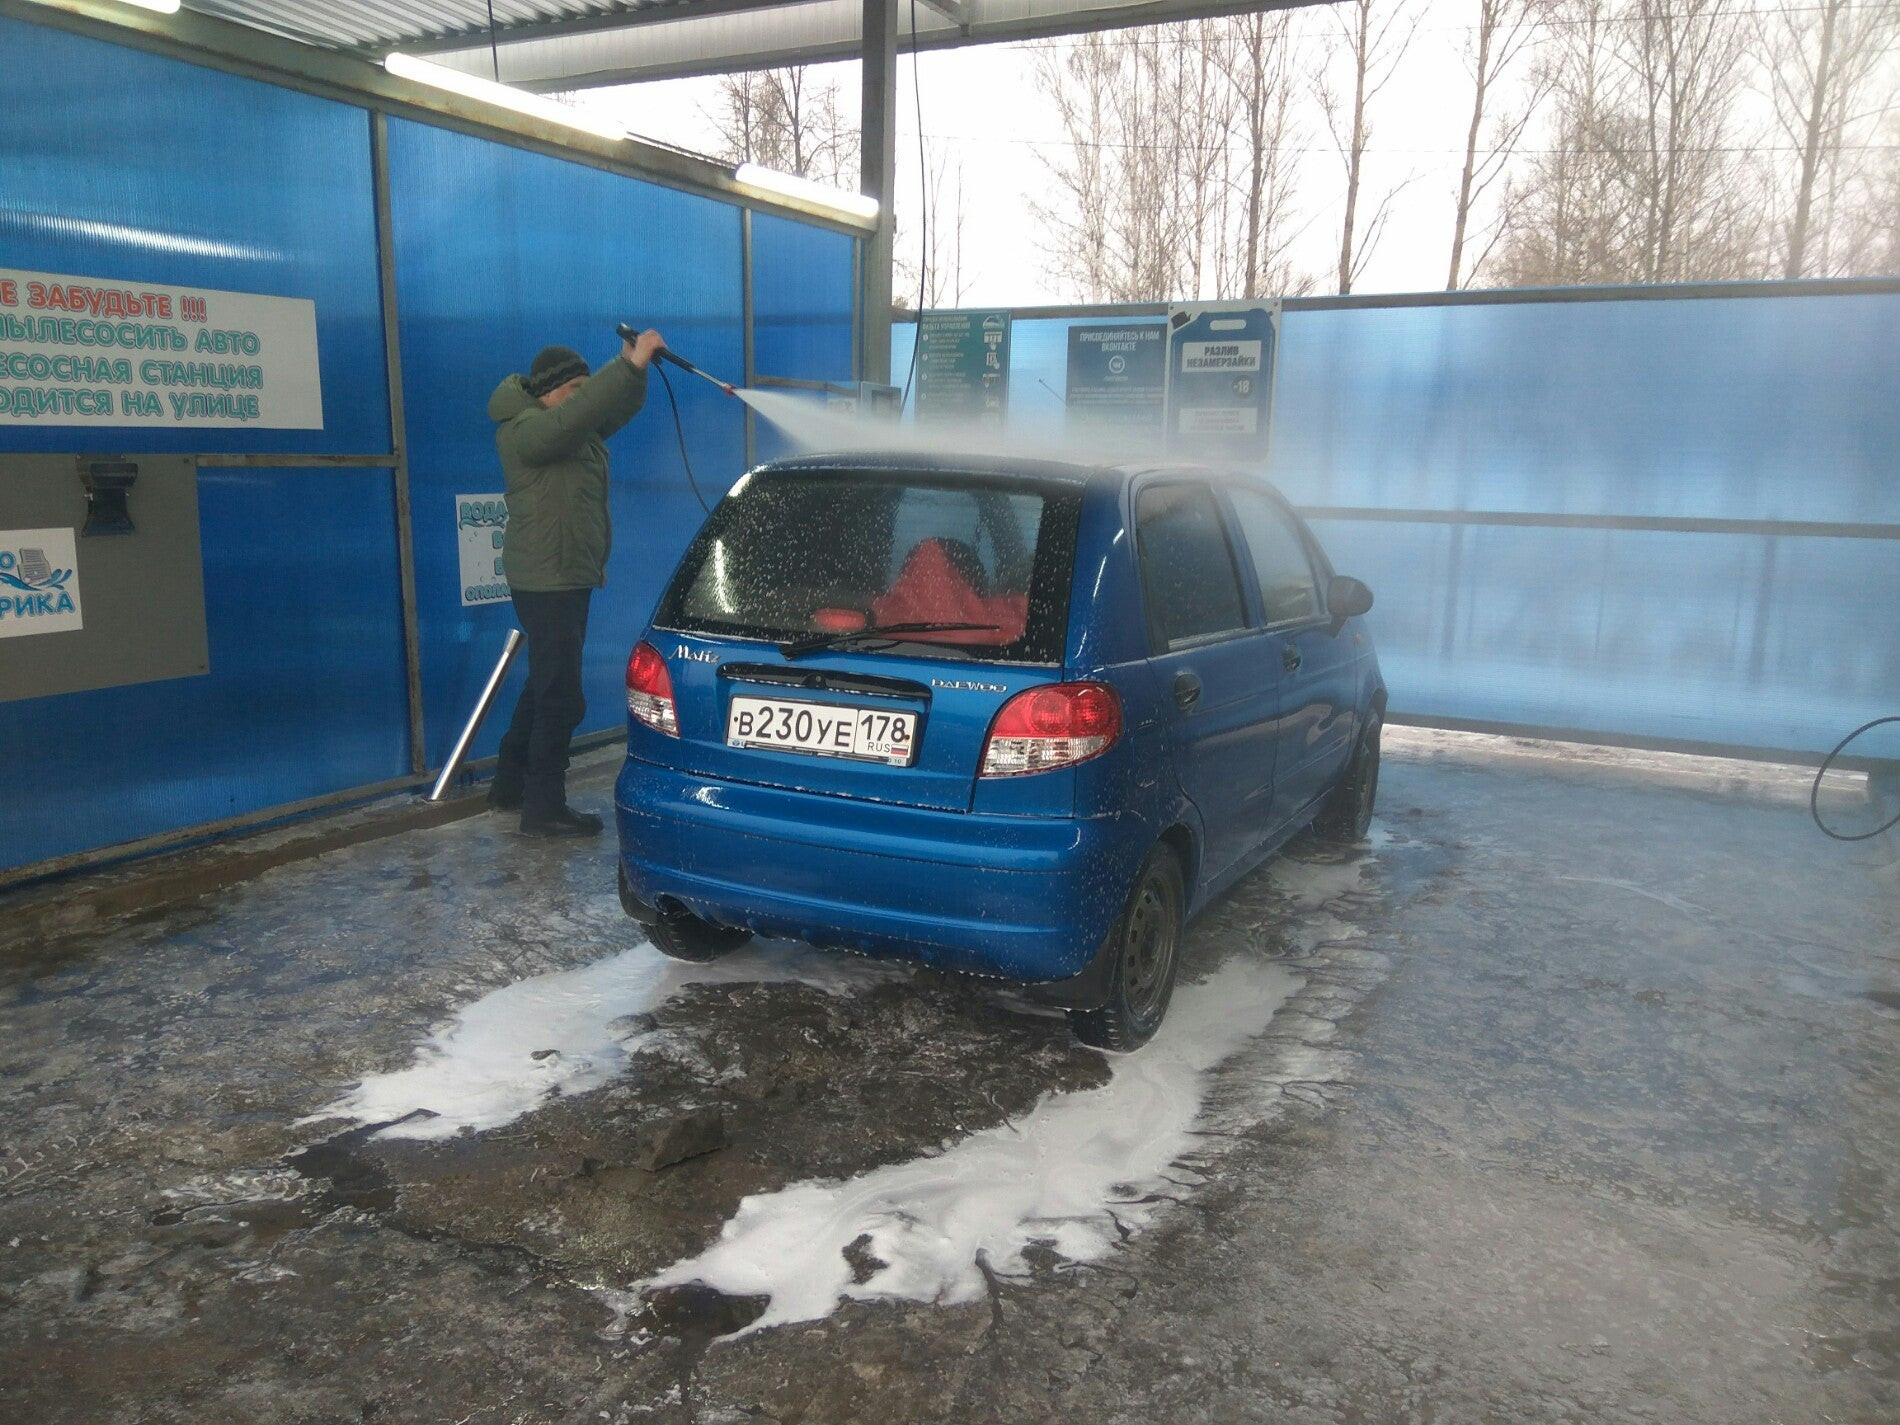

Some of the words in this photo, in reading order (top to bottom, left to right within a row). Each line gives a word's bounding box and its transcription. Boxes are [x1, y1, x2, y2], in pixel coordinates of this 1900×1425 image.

[27, 282, 173, 319] ЗАБУДЬТЕ
[181, 295, 207, 323] !!!
[195, 329, 261, 356] АВТО
[1204, 346, 1239, 356] РАЗЛИВ
[1187, 356, 1256, 368] НЕЗАМЕРЗАЙКИ
[140, 360, 264, 392] СТАНЦИЯ
[1233, 380, 1250, 394] -18
[121, 390, 164, 417] НА
[169, 392, 260, 421] УЛИЦЕ
[0, 591, 76, 619] РИКА
[668, 644, 720, 664] Matiz
[931, 678, 1007, 693] DAEWOO
[738, 706, 852, 747] В230УЕ
[861, 714, 906, 743] 178
[867, 741, 890, 753] RUS
